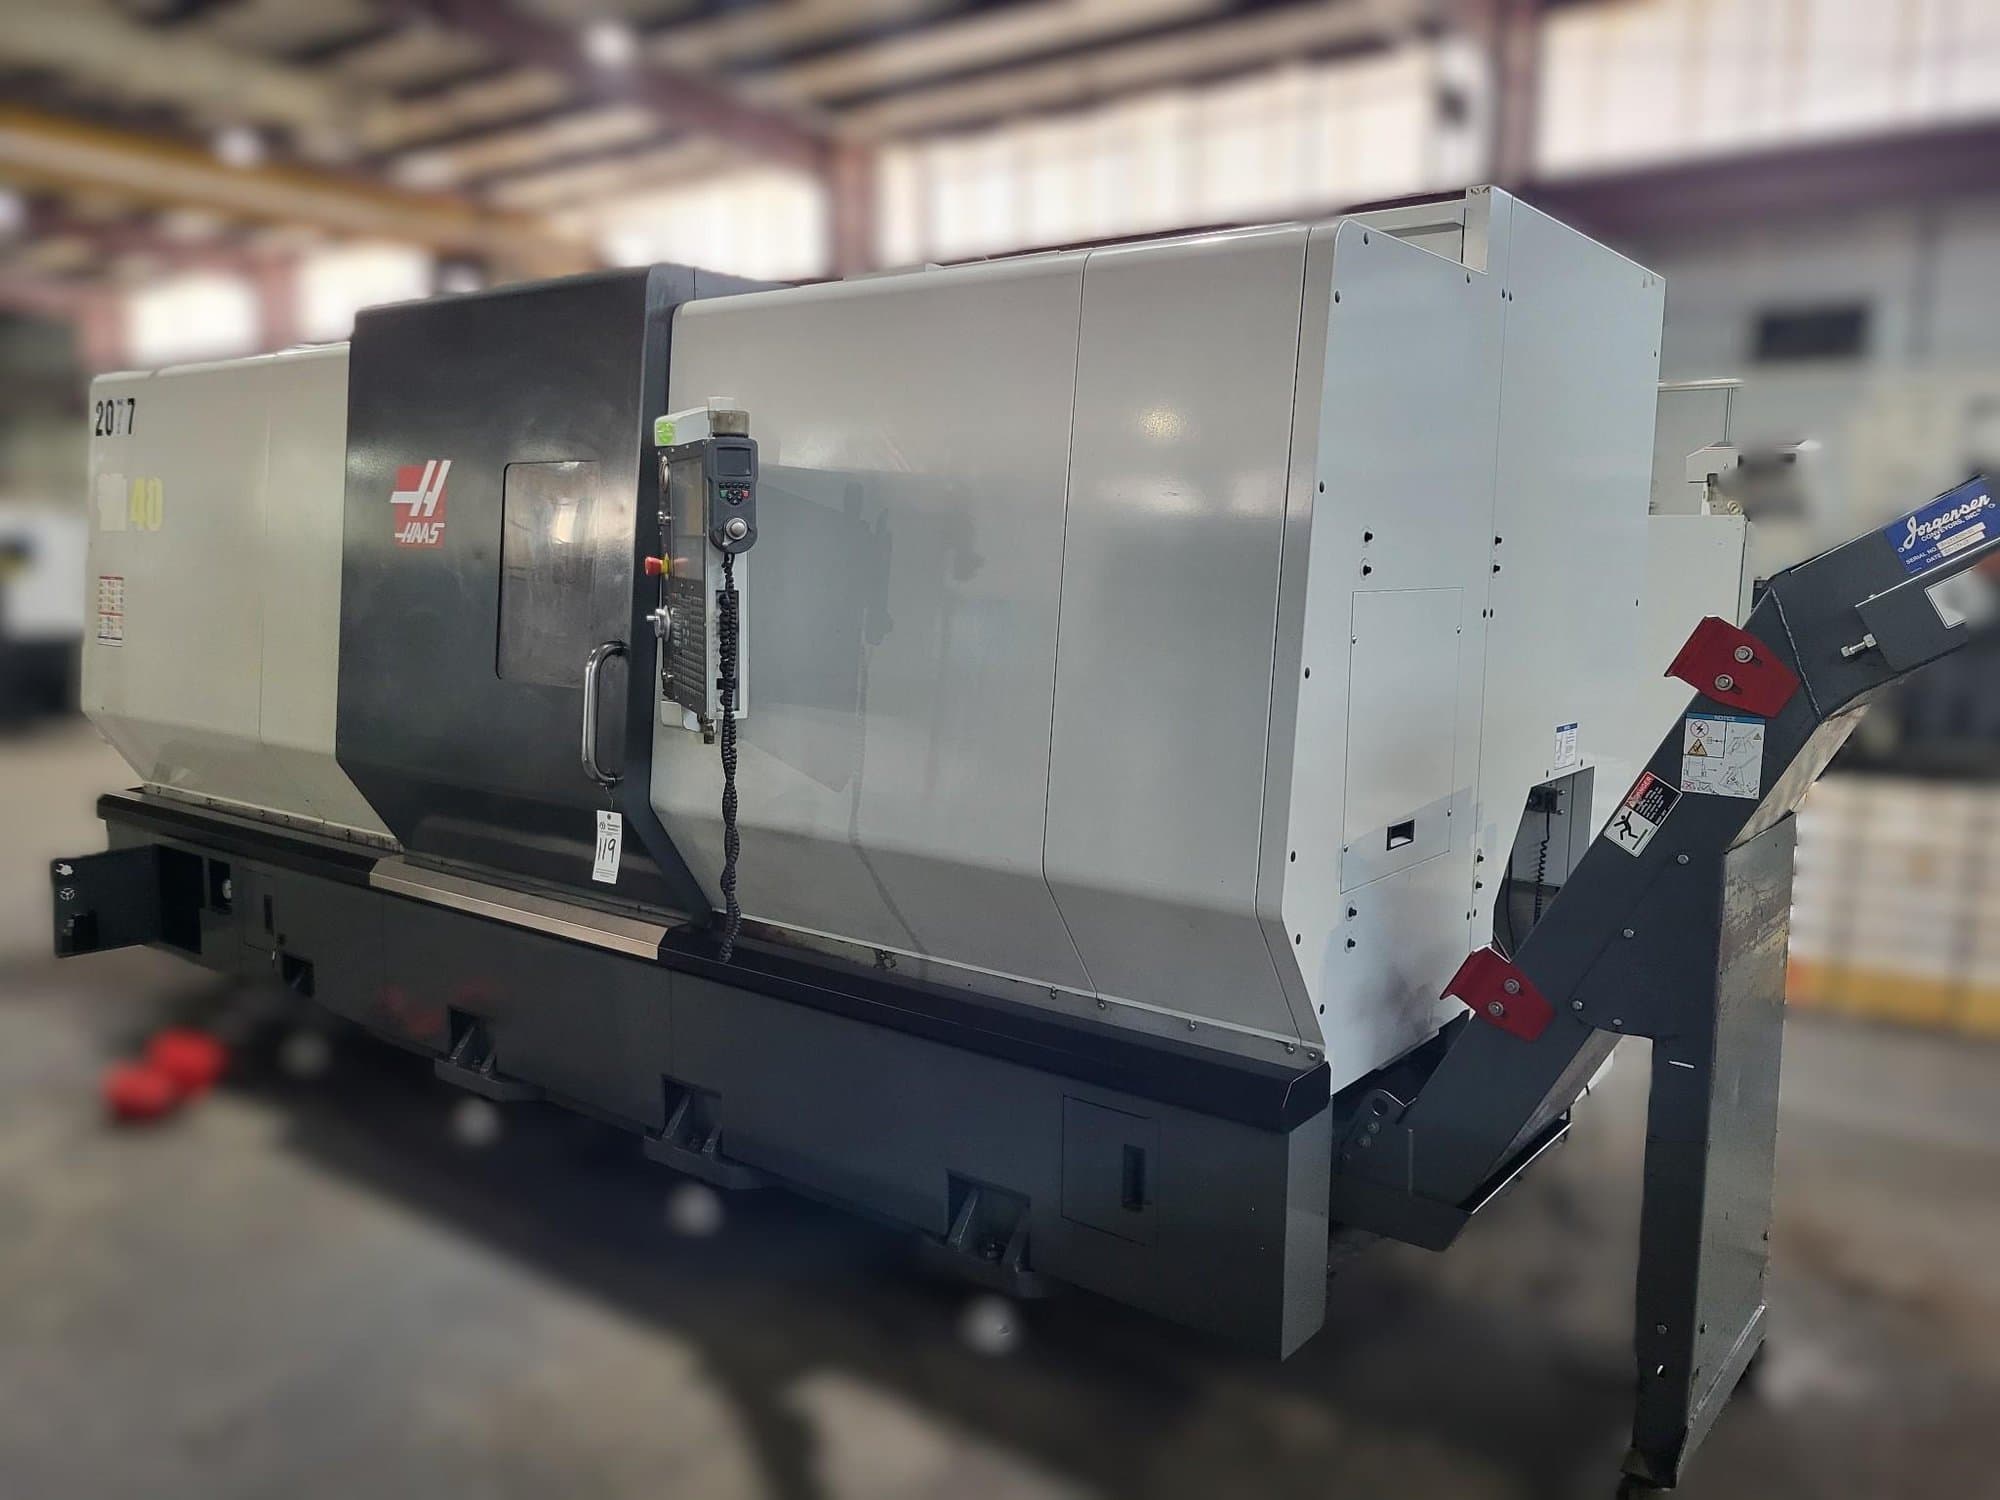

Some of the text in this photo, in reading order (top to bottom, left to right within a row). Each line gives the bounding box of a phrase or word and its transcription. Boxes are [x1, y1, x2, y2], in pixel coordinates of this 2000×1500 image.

[1903, 494, 1991, 549] Jorgensen
[394, 522, 446, 544] HAAS
[1905, 552, 1928, 565] SERIAL
[1926, 552, 1942, 563] DATE
[597, 837, 617, 864] 119
